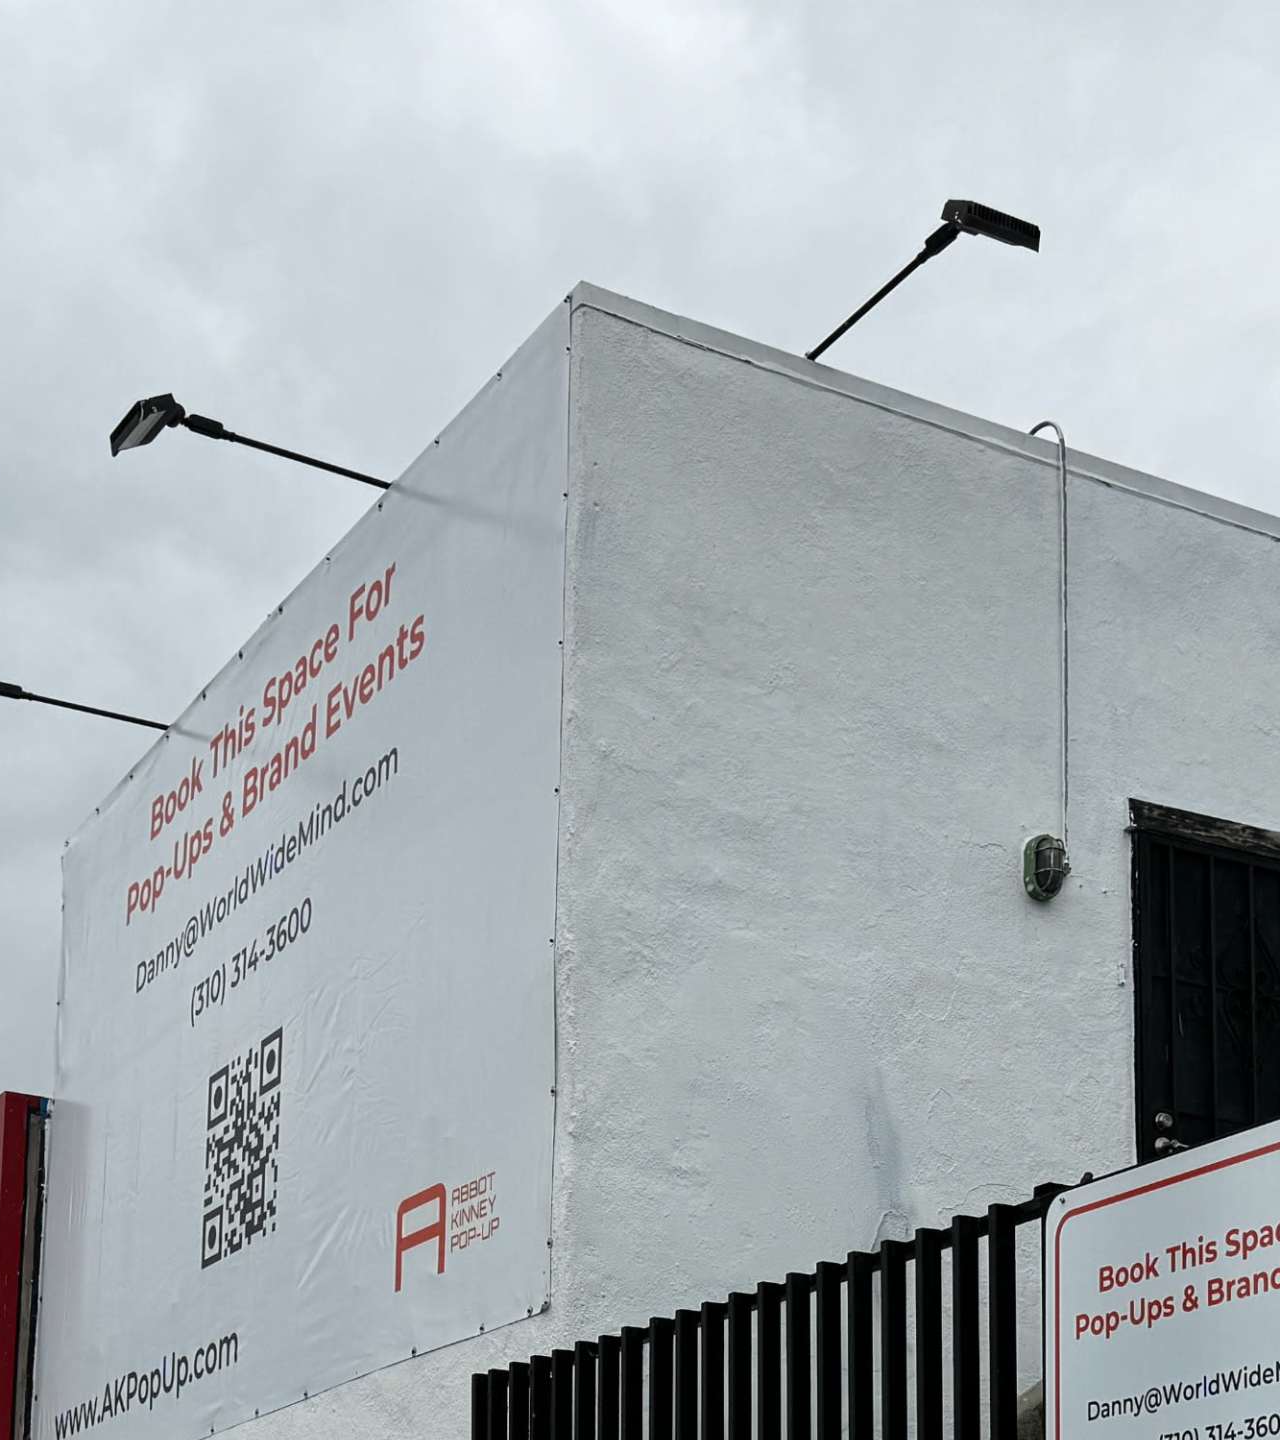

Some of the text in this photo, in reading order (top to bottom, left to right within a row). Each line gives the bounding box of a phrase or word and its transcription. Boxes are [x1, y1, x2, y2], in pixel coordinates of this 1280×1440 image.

[150, 560, 397, 841] Book This Space For
[125, 613, 425, 927] Pop-Ups & Brand Events
[134, 746, 399, 994] Danny@WorldWideMind.com
[189, 896, 313, 1027] (310) 314-3600
[450, 1194, 497, 1231] KINNEY
[451, 1171, 496, 1207] ABBOT
[450, 1216, 500, 1254] POP-UP
[1097, 1251, 1160, 1293] Book
[1165, 1235, 1218, 1274] This
[1075, 1295, 1175, 1340] Pop-Ups
[1181, 1284, 1199, 1313] &
[54, 1328, 239, 1440] www.AKPopUp.com
